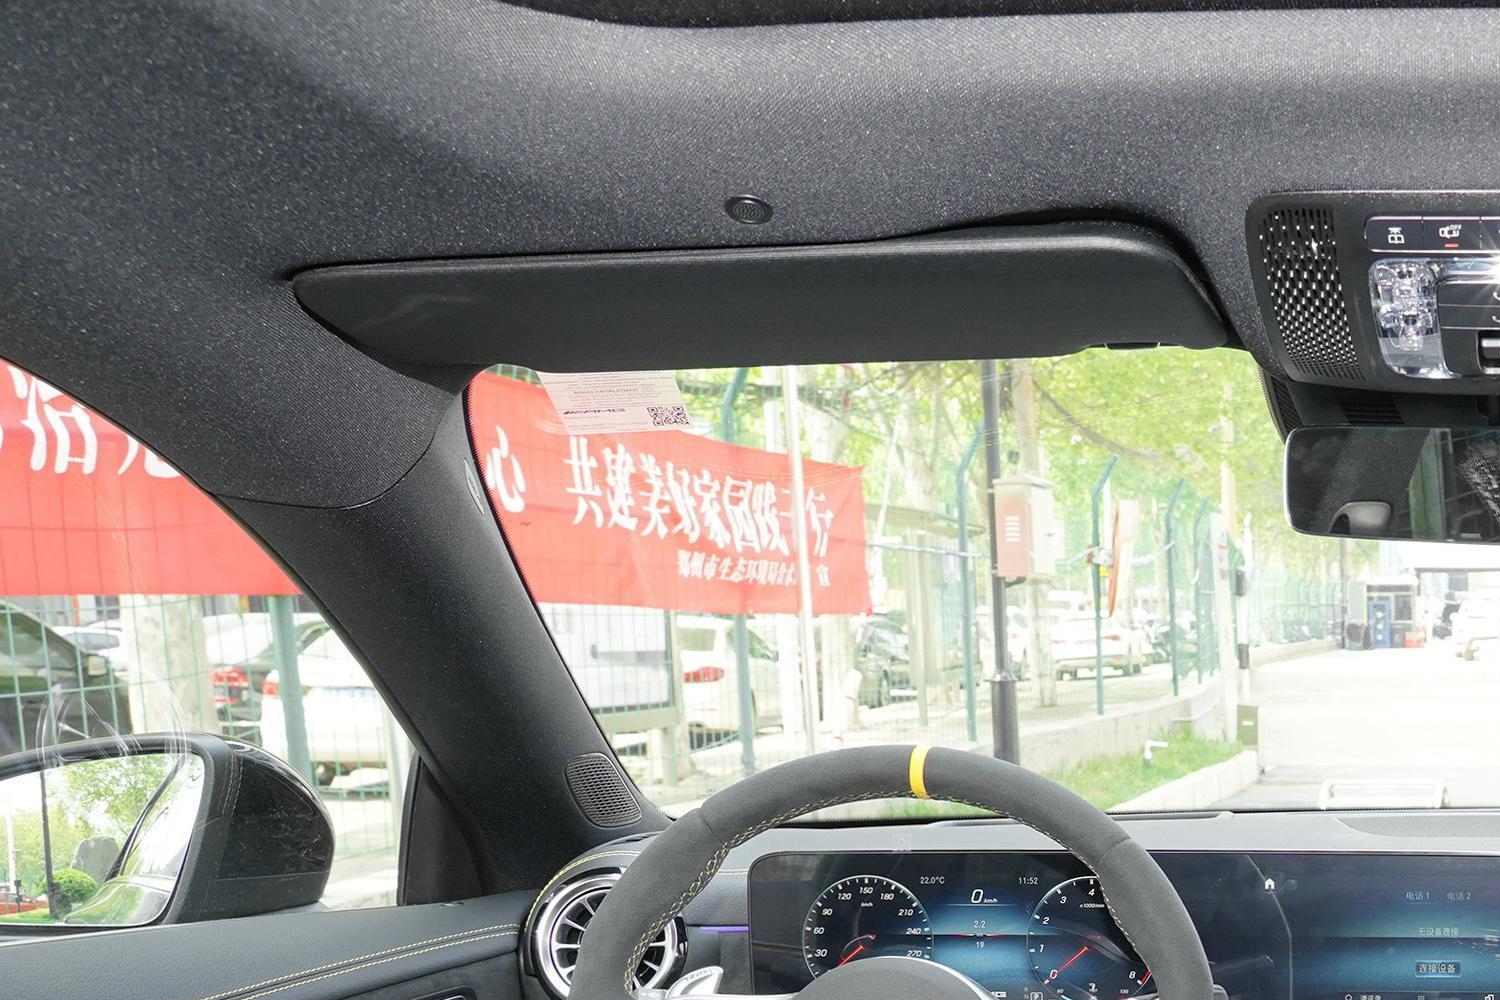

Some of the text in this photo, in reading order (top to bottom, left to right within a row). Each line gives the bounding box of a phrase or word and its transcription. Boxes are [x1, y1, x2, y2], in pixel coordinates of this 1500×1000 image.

[485, 425, 834, 557] 心 共建美好家园践行
[920, 876, 945, 884] 22.0°C
[1018, 876, 1039, 885] 11:52
[859, 886, 874, 894] 150
[1088, 888, 1095, 896] 4
[971, 889, 984, 904] 0
[1405, 891, 1424, 900] 电话
[1446, 891, 1465, 900] 电话
[1059, 896, 1067, 904] 3
[821, 908, 833, 916] 90
[1042, 916, 1050, 925] 2
[813, 927, 825, 935] 60
[905, 927, 921, 935] 240
[1417, 927, 1460, 937] 无设备连接
[976, 941, 985, 949] 19
[1039, 944, 1044, 952] 1
[814, 949, 828, 957] 30
[1418, 963, 1457, 974] 连接设备
[1049, 969, 1058, 979] 0
[1129, 970, 1136, 979] 8
